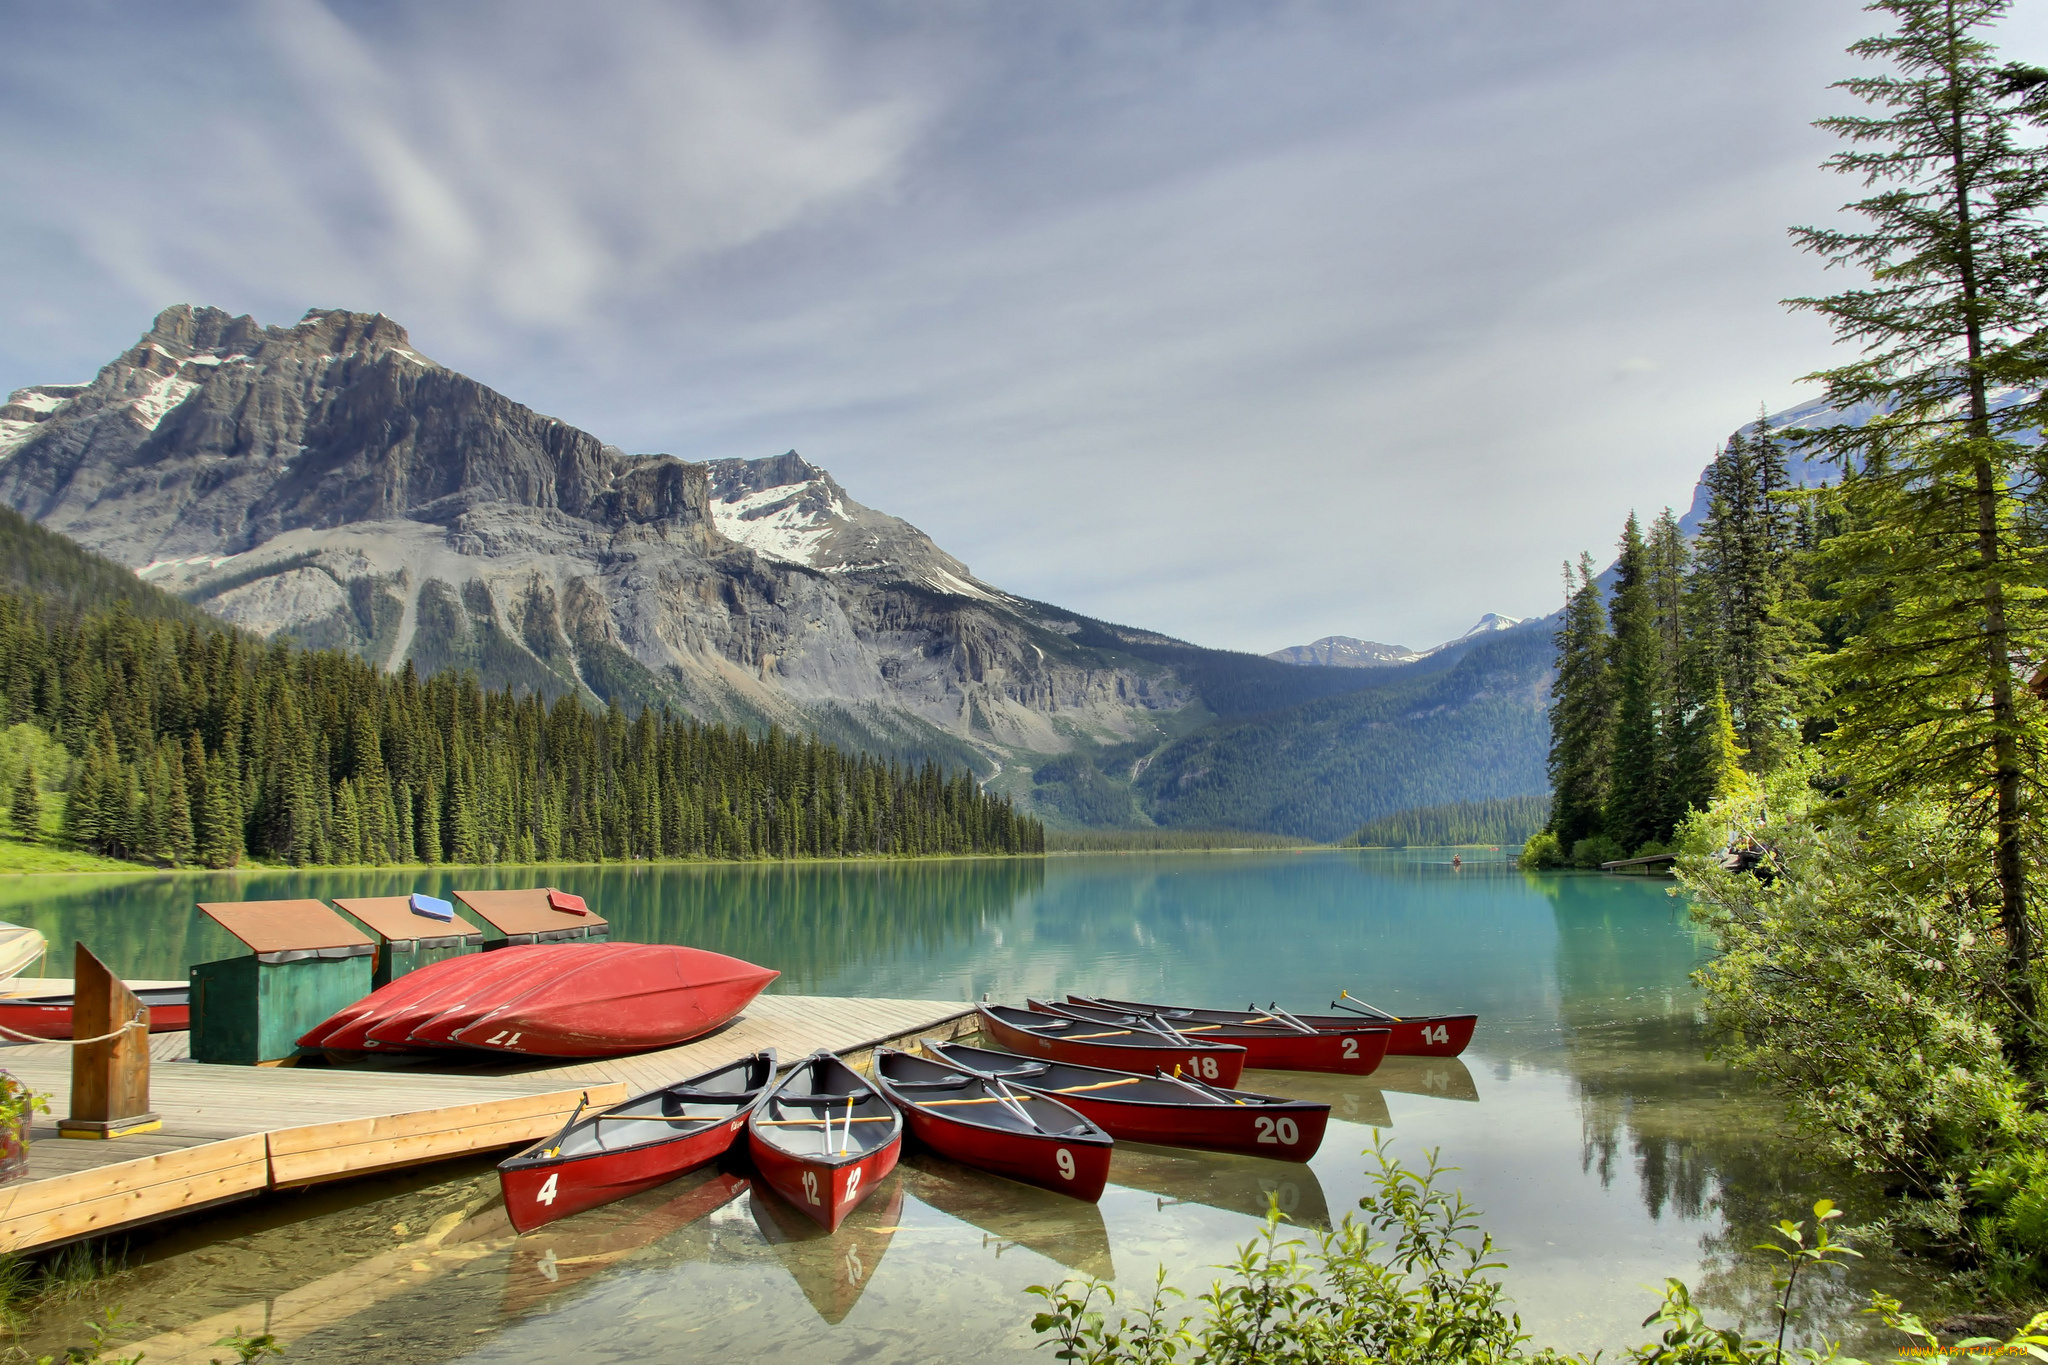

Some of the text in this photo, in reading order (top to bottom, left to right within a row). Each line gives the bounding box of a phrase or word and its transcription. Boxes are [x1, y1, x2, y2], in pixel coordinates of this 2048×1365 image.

[485, 1030, 522, 1047] 17
[1341, 1038, 1360, 1059] 2
[1421, 1025, 1450, 1045] 14
[1188, 1056, 1219, 1079] 18
[1254, 1116, 1299, 1145] 20
[1056, 1148, 1075, 1180] 9
[536, 1173, 558, 1206] 4
[801, 1170, 821, 1206] 12
[844, 1166, 861, 1203] 12
